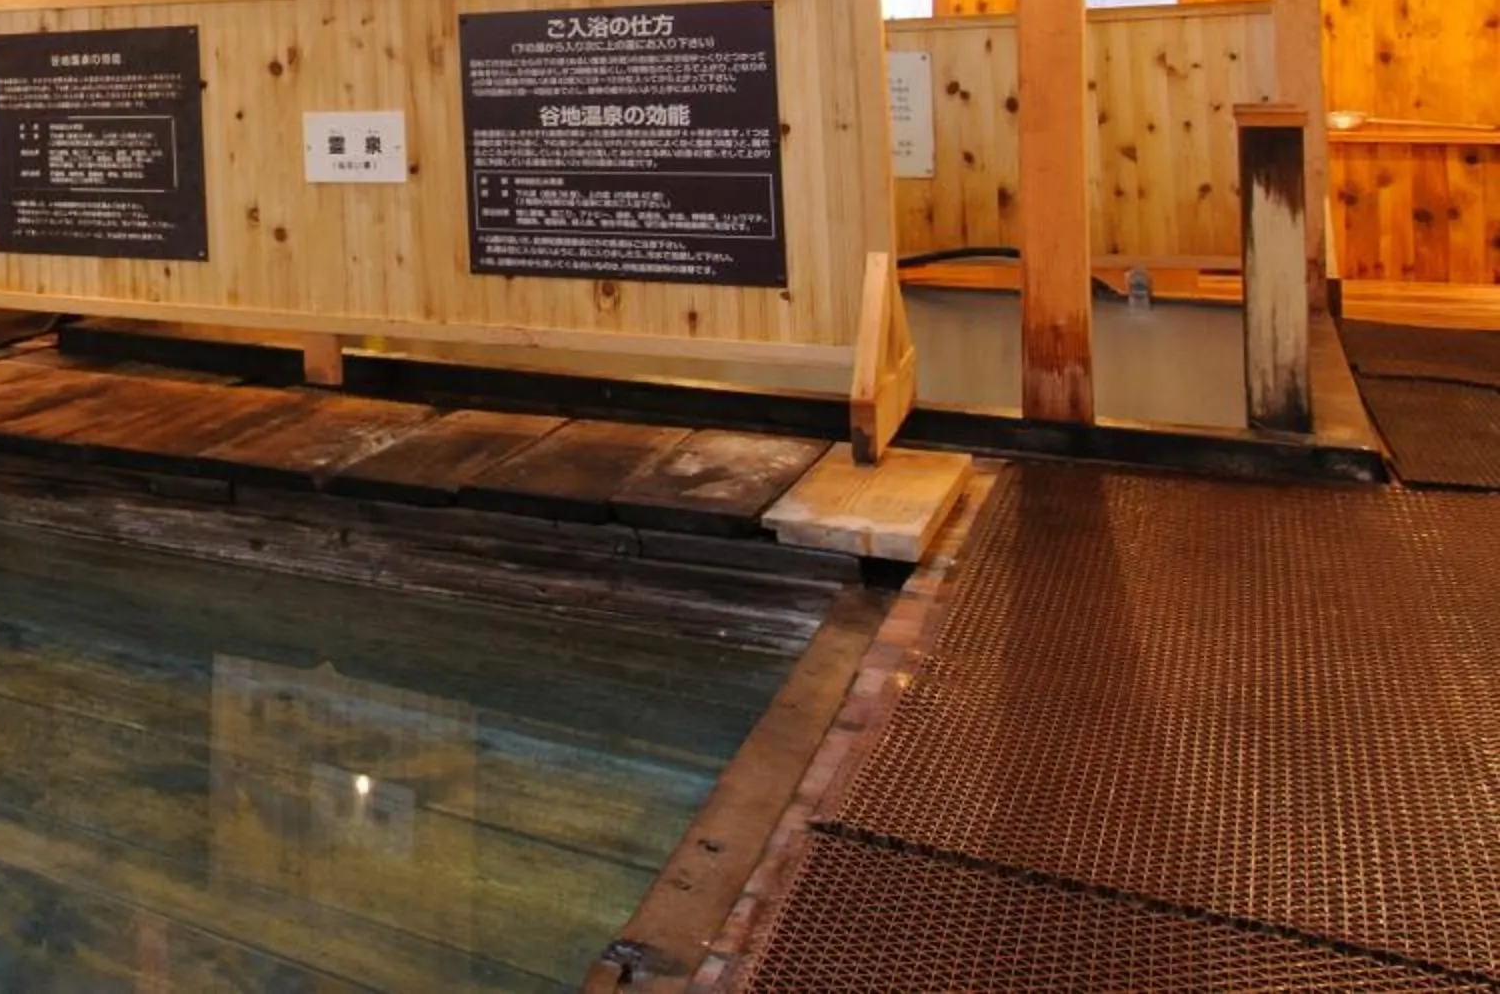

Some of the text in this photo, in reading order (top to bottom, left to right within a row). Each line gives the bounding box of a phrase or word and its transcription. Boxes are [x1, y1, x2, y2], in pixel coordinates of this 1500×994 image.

[547, 14, 675, 38] ご入浴の仕方
[540, 105, 691, 127] 谷地温泉の効能
